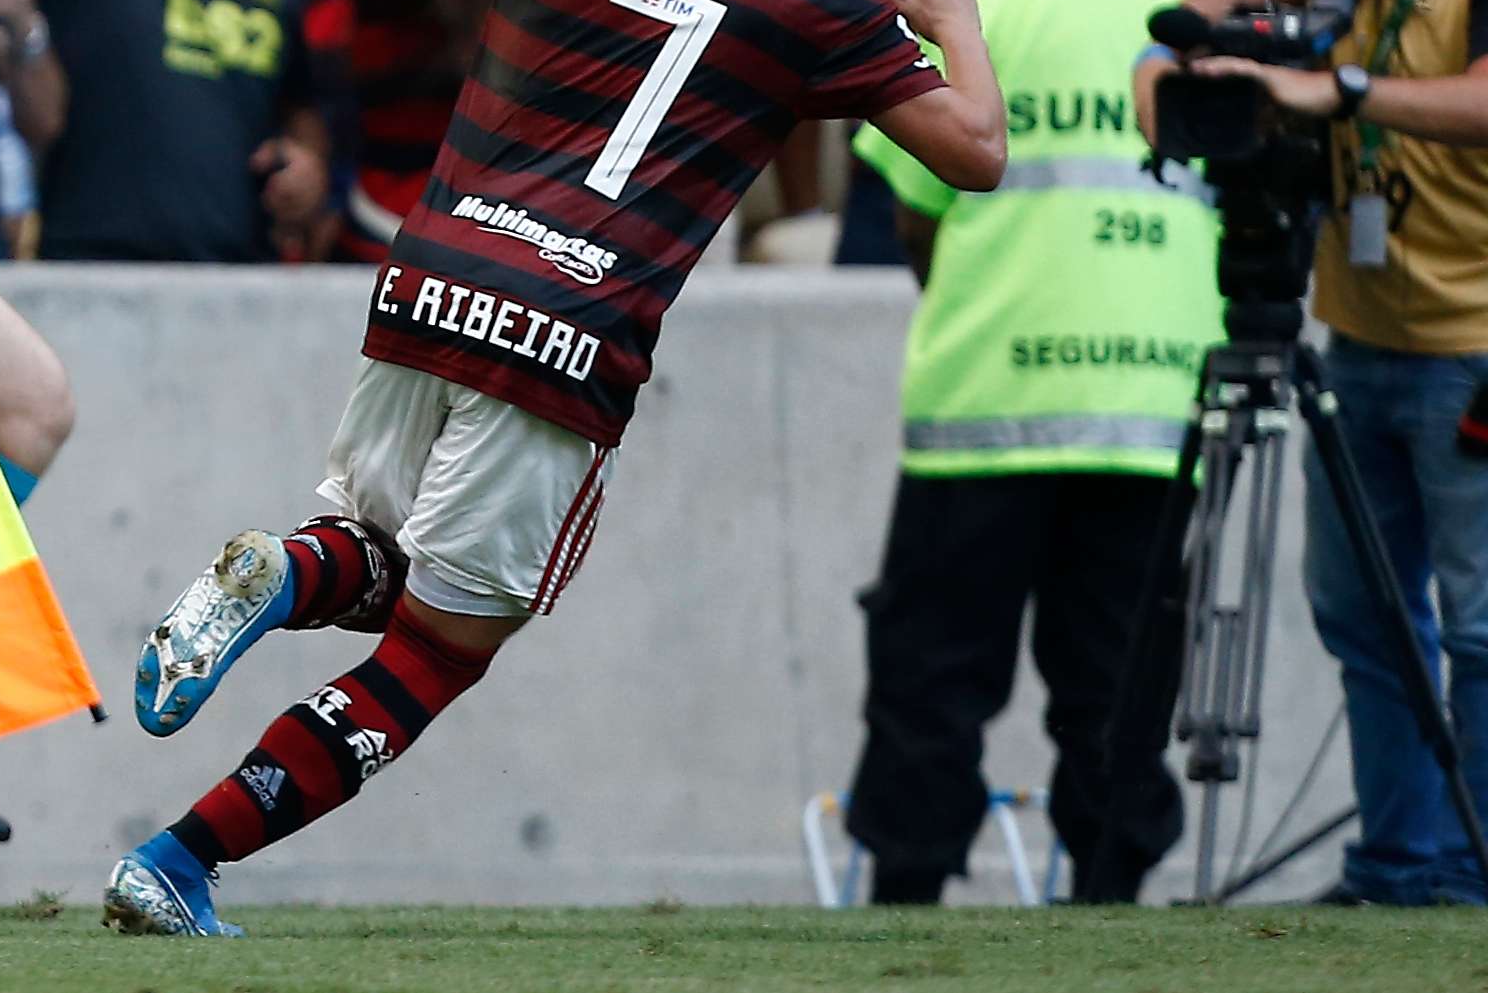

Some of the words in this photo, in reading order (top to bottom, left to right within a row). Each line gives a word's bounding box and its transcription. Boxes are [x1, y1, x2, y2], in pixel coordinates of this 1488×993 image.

[1007, 91, 1126, 133] SUN
[451, 196, 618, 270] Multimarcas
[377, 266, 403, 315] E.
[411, 276, 602, 382] RIBEIRO
